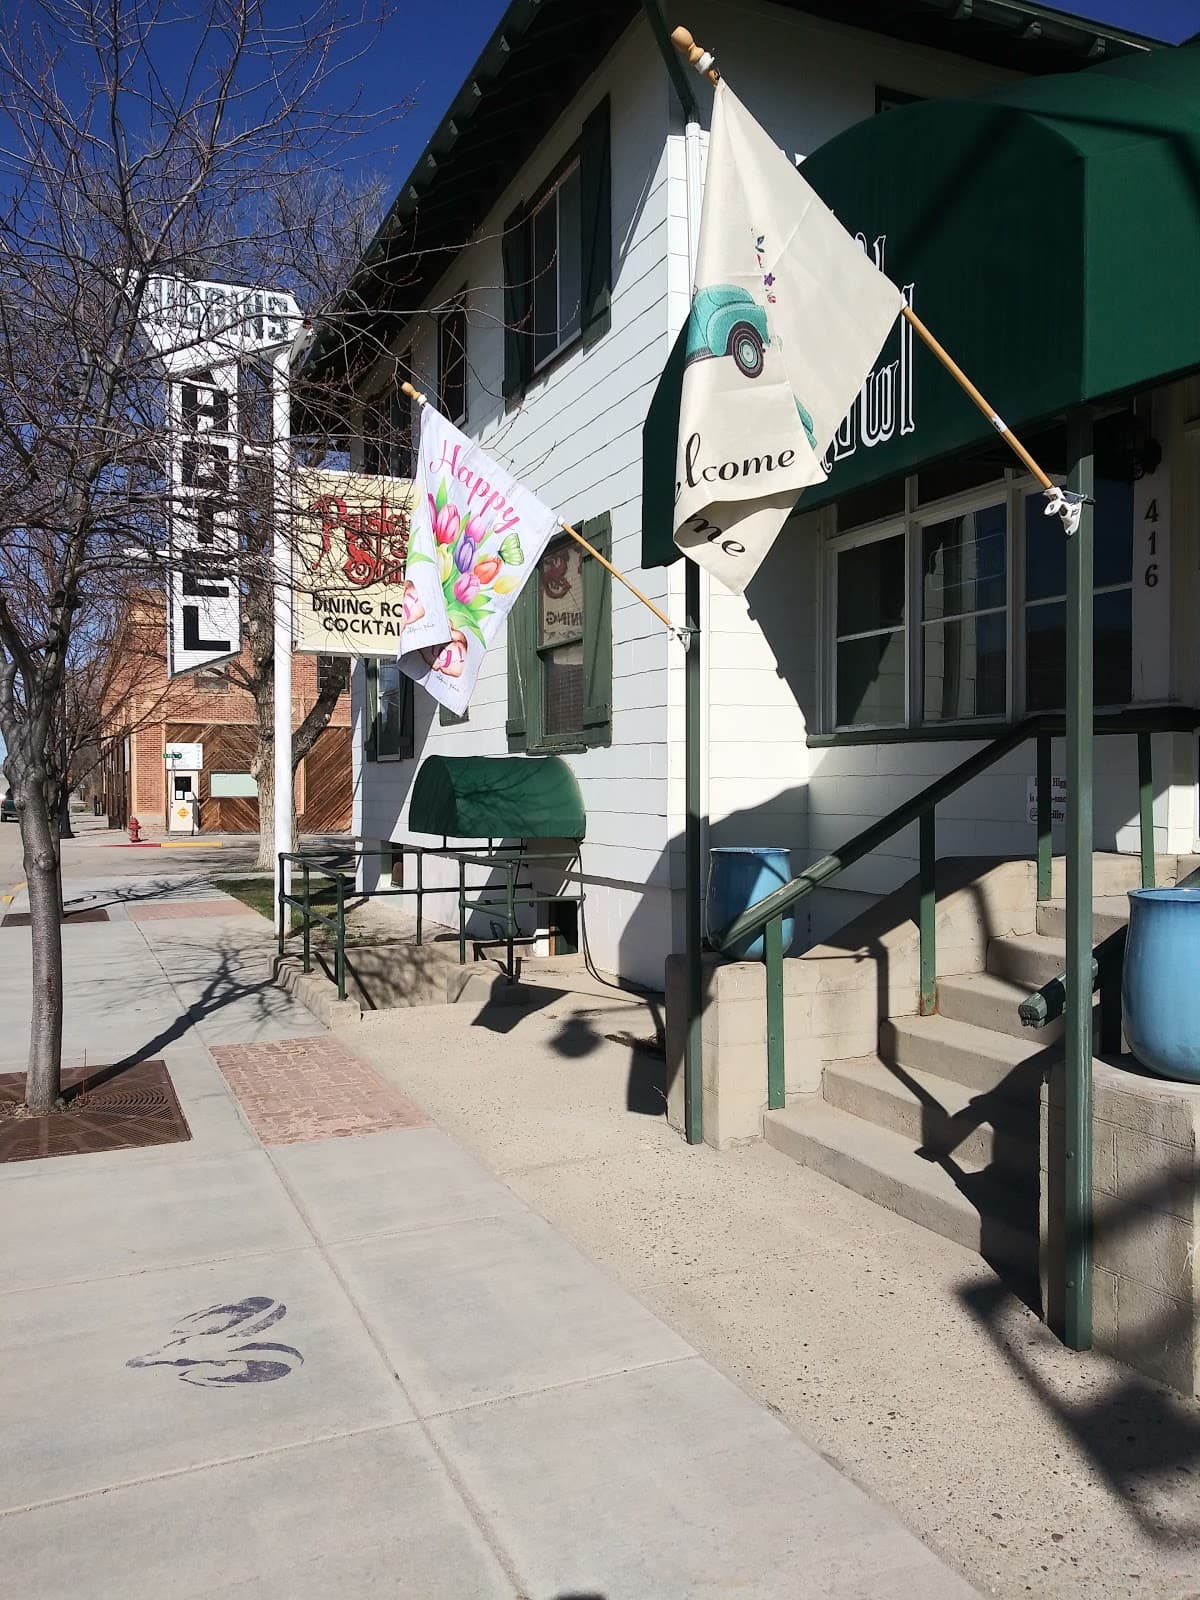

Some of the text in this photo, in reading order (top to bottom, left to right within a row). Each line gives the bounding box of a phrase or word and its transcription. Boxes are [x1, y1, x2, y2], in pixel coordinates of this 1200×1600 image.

[429, 439, 520, 533] Happy
[675, 432, 795, 505] lcome
[181, 384, 231, 652] HOTEL
[1144, 499, 1159, 588] 416
[312, 596, 373, 615] DINING
[324, 617, 401, 636] COCKTAI
